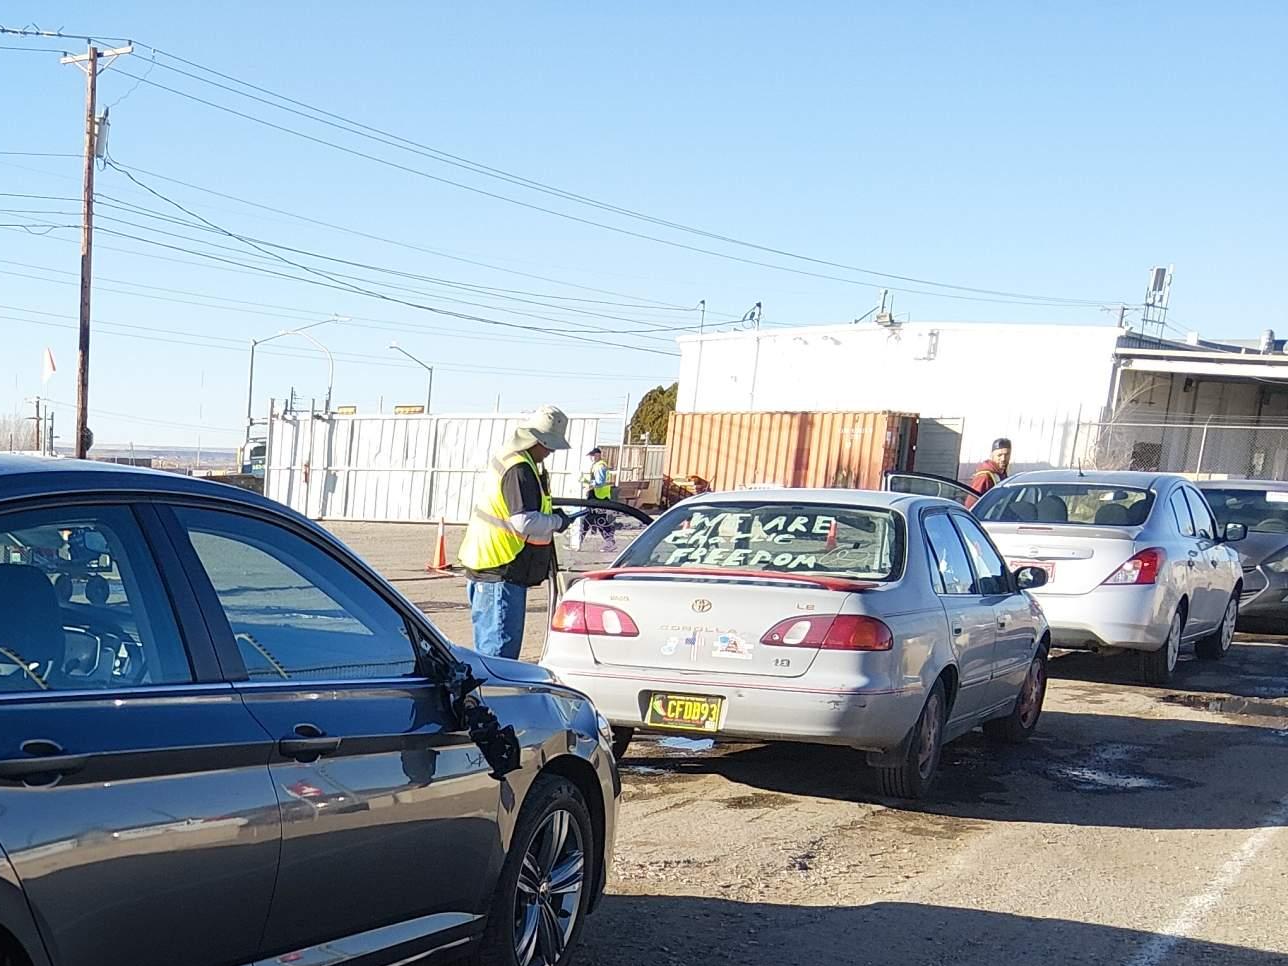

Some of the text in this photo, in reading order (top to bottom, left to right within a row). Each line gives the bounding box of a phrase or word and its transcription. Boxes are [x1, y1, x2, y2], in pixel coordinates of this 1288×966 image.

[690, 512, 835, 534] WE ARE
[664, 547, 817, 568] FREEDOM
[796, 602, 815, 611] LE
